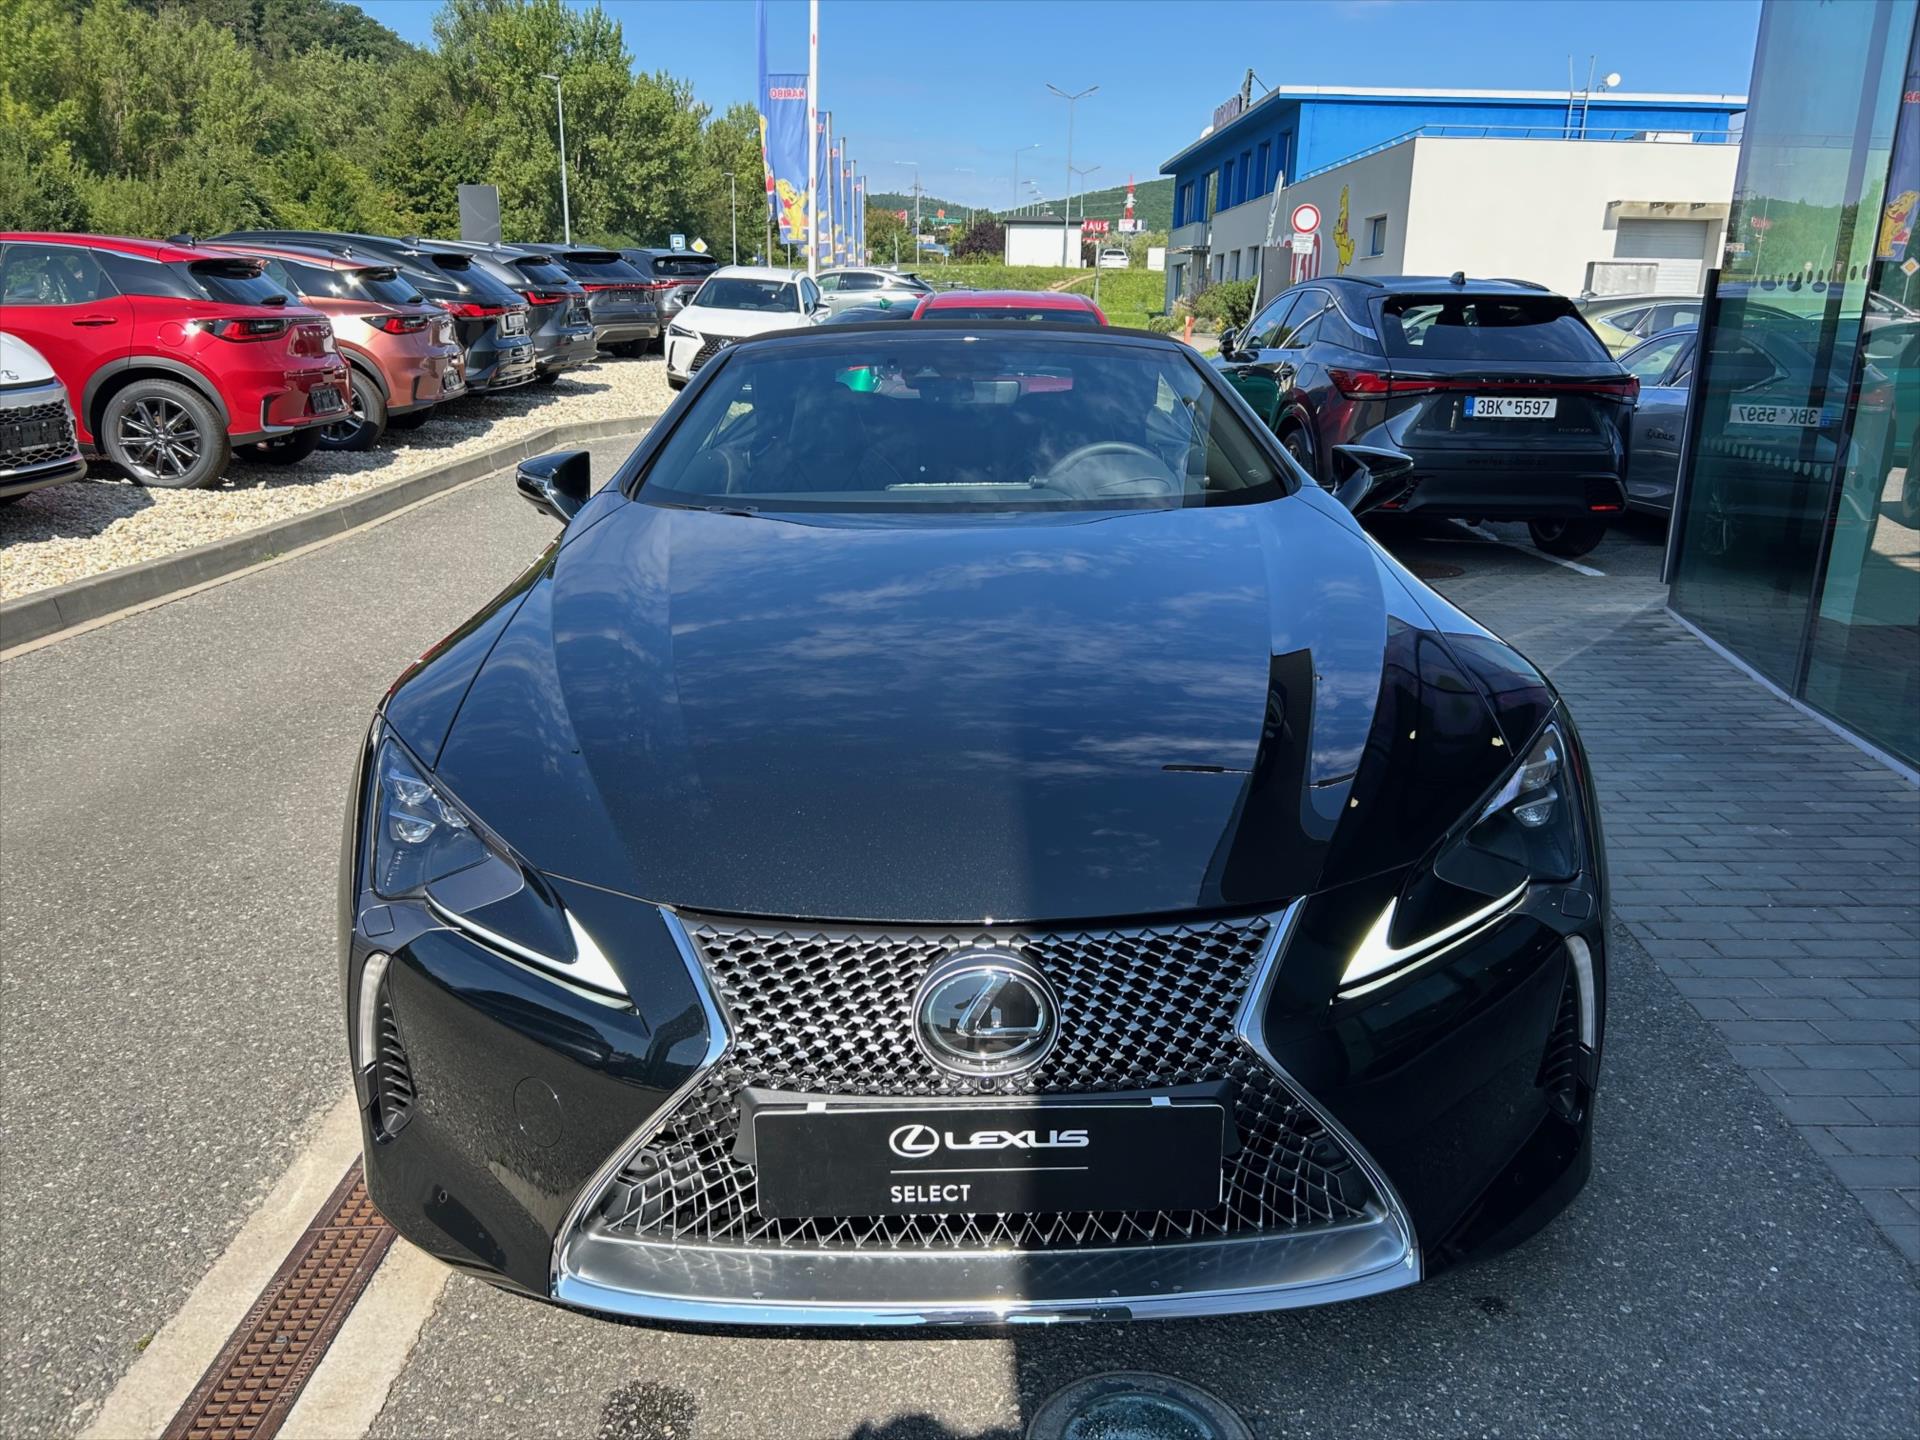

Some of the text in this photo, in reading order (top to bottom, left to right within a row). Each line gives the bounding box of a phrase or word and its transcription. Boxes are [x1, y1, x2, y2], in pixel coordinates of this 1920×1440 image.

[1477, 399, 1504, 415] 3BK
[1514, 400, 1550, 416] 5597
[944, 1130, 1090, 1150] LEXUS
[890, 1184, 971, 1203] SELECT
